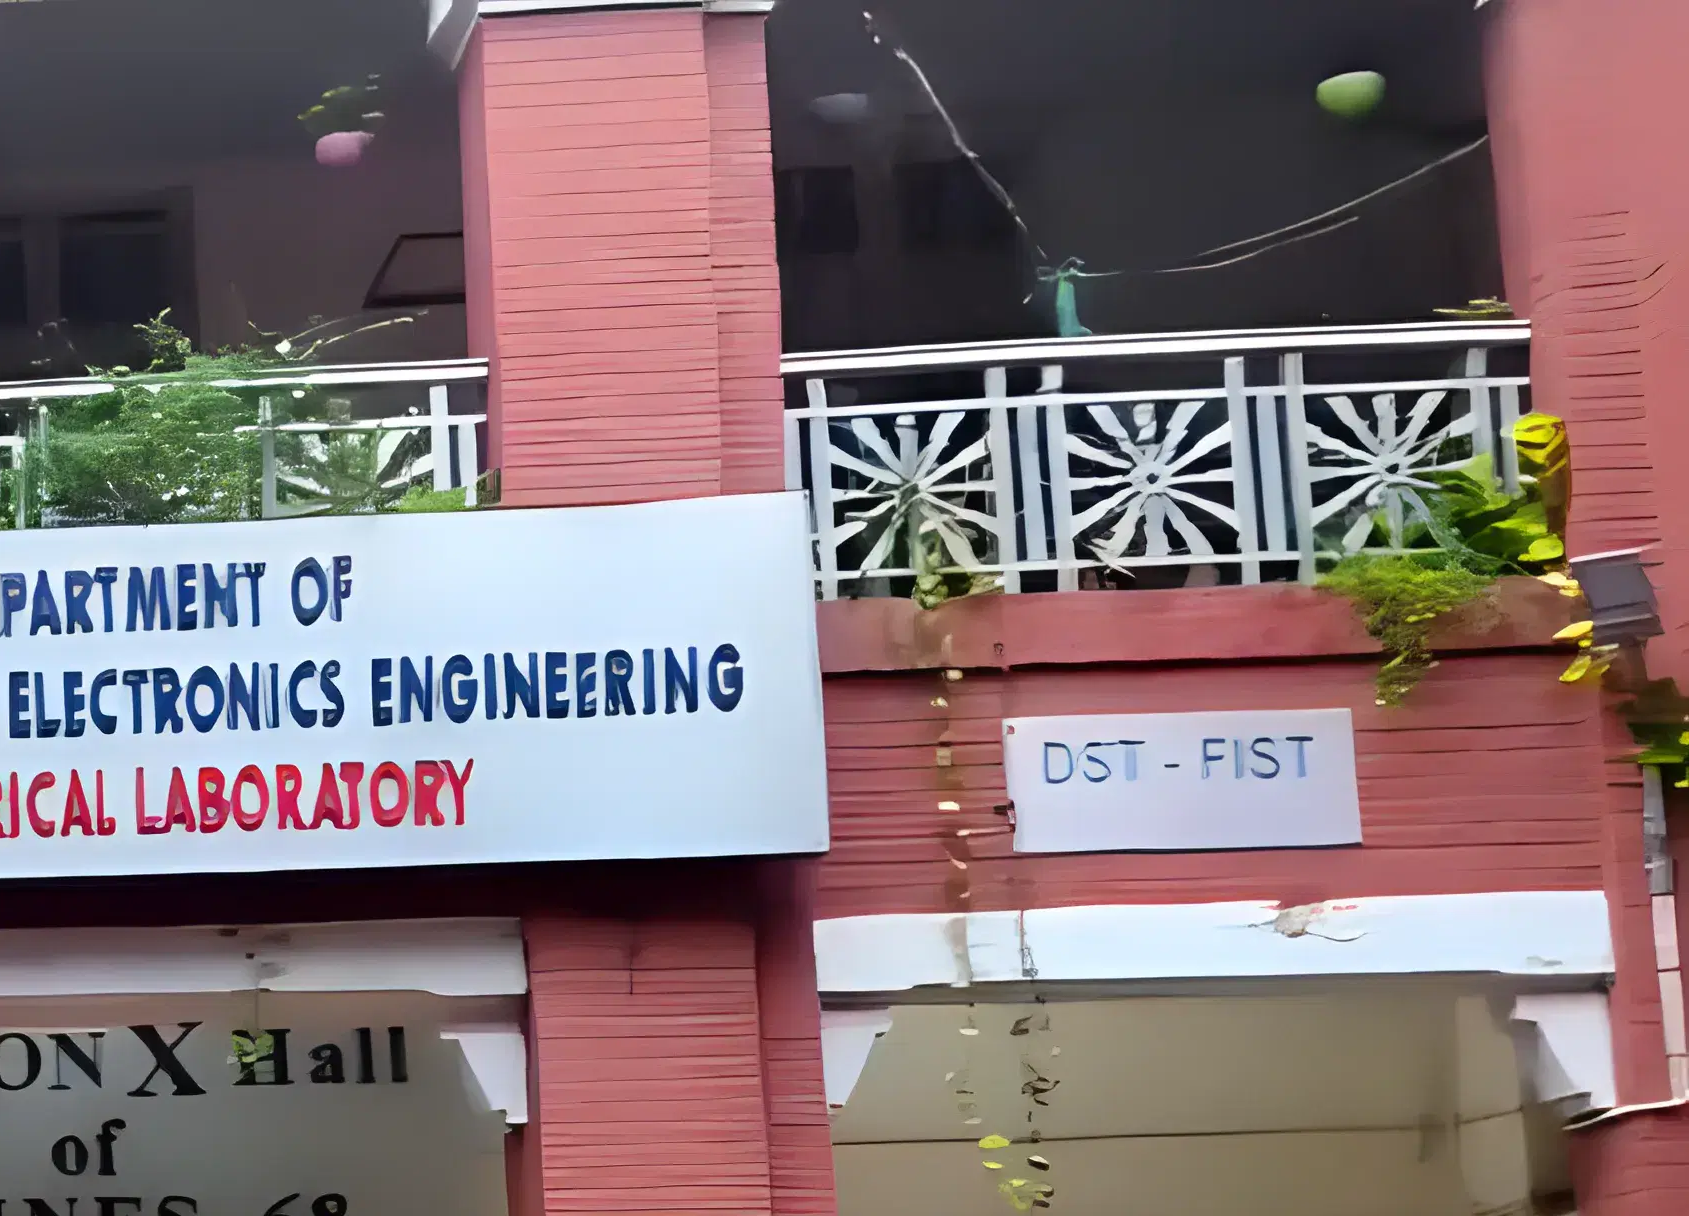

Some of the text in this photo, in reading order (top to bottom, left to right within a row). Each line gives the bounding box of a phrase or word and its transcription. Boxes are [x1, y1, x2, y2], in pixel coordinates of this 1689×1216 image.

[290, 555, 353, 627] OF
[8, 659, 346, 739] ELECTRONICS
[371, 643, 744, 728] ENGINEERING
[1043, 738, 1147, 785] DST
[1200, 735, 1314, 781] FIST
[135, 757, 475, 836] LABORATORY
[231, 1025, 410, 1086] Hall
[50, 1118, 127, 1177] of
